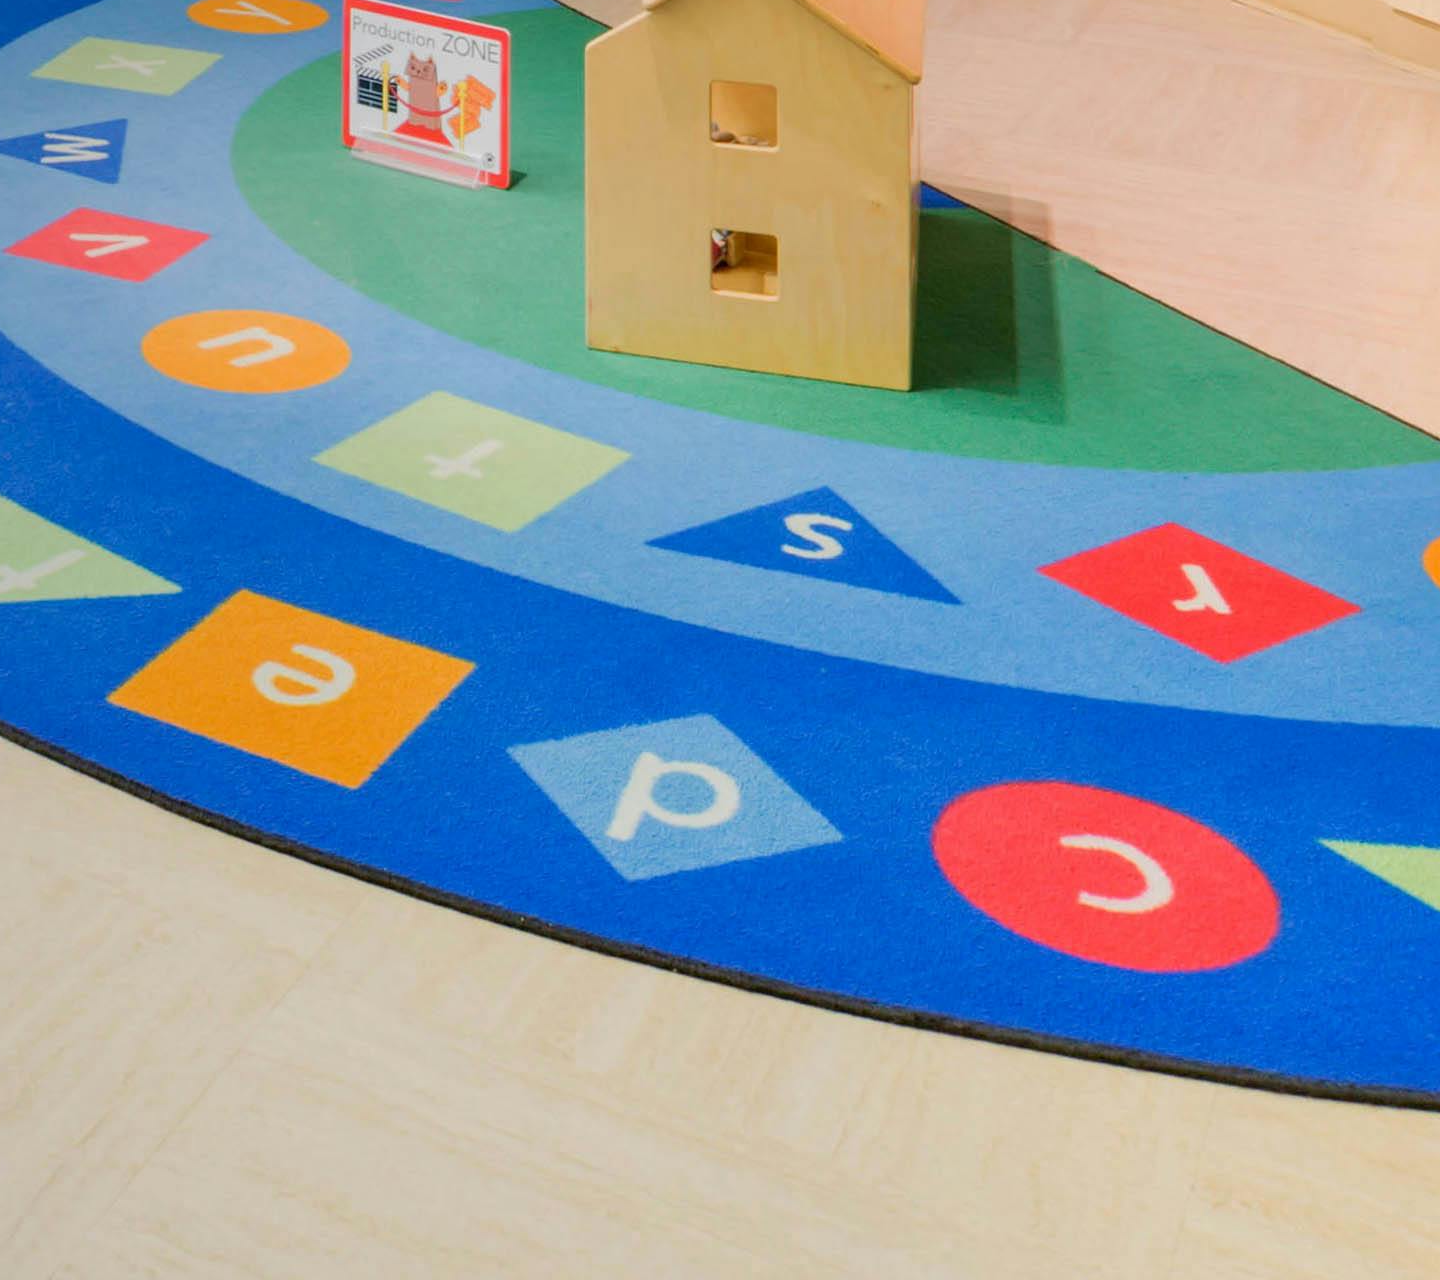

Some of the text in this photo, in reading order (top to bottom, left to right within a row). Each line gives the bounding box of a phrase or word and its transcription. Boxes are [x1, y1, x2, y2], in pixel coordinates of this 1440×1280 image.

[216, 2, 297, 29] y
[352, 15, 500, 64] Production ZONE
[96, 55, 168, 77] x
[41, 133, 110, 165] w
[69, 229, 148, 259] v
[199, 325, 295, 367] u
[426, 438, 514, 480] t
[782, 511, 853, 560] s
[1173, 564, 1231, 614] r
[252, 644, 356, 705] e
[606, 752, 740, 841] d
[1060, 834, 1174, 912] c
